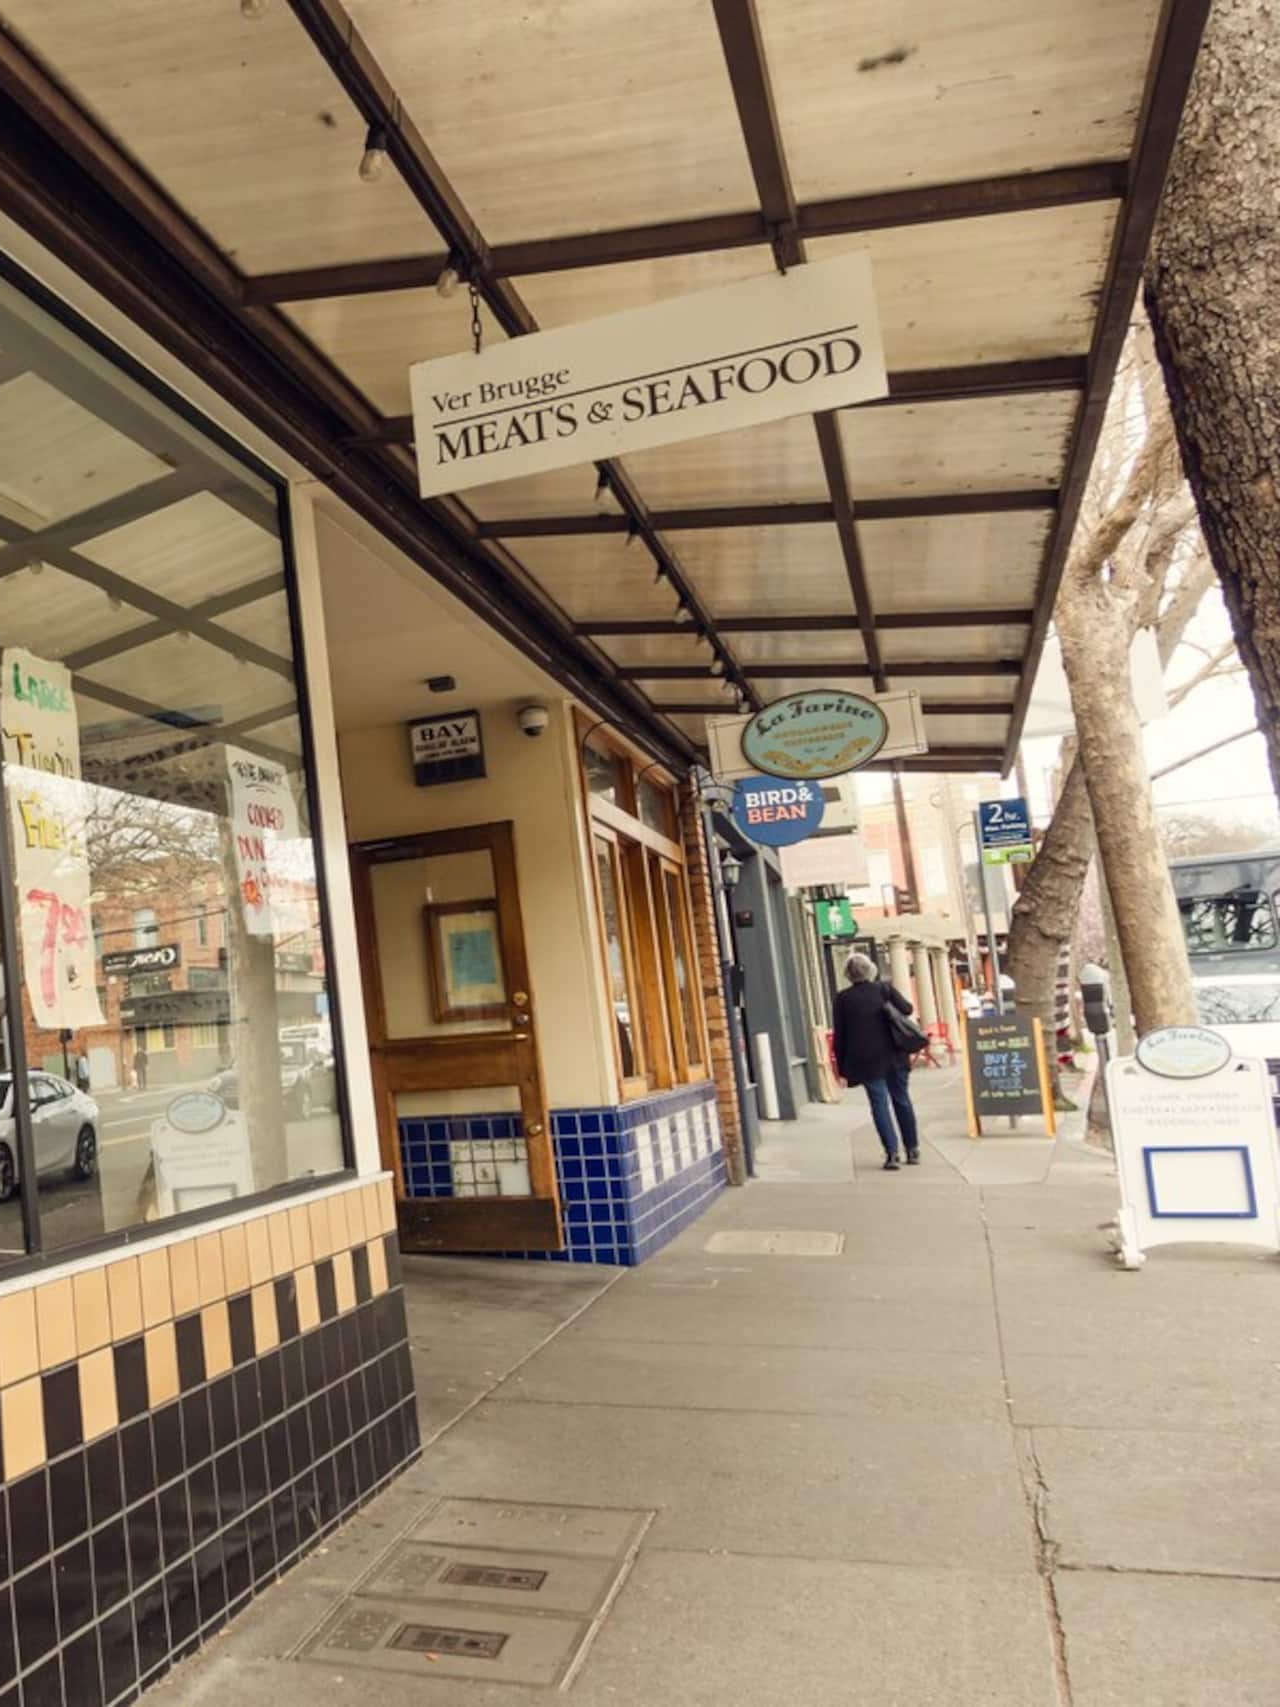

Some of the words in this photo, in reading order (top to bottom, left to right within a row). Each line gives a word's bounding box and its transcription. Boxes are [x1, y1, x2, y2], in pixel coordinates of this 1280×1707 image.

[432, 390, 472, 414] Ver
[479, 367, 571, 405] Brugge
[435, 401, 578, 466] MEATS
[586, 400, 615, 424] &
[621, 337, 863, 423] SEAFOOD
[421, 721, 468, 742] BAY
[747, 804, 808, 825] BEAN
[989, 803, 1004, 823] 2
